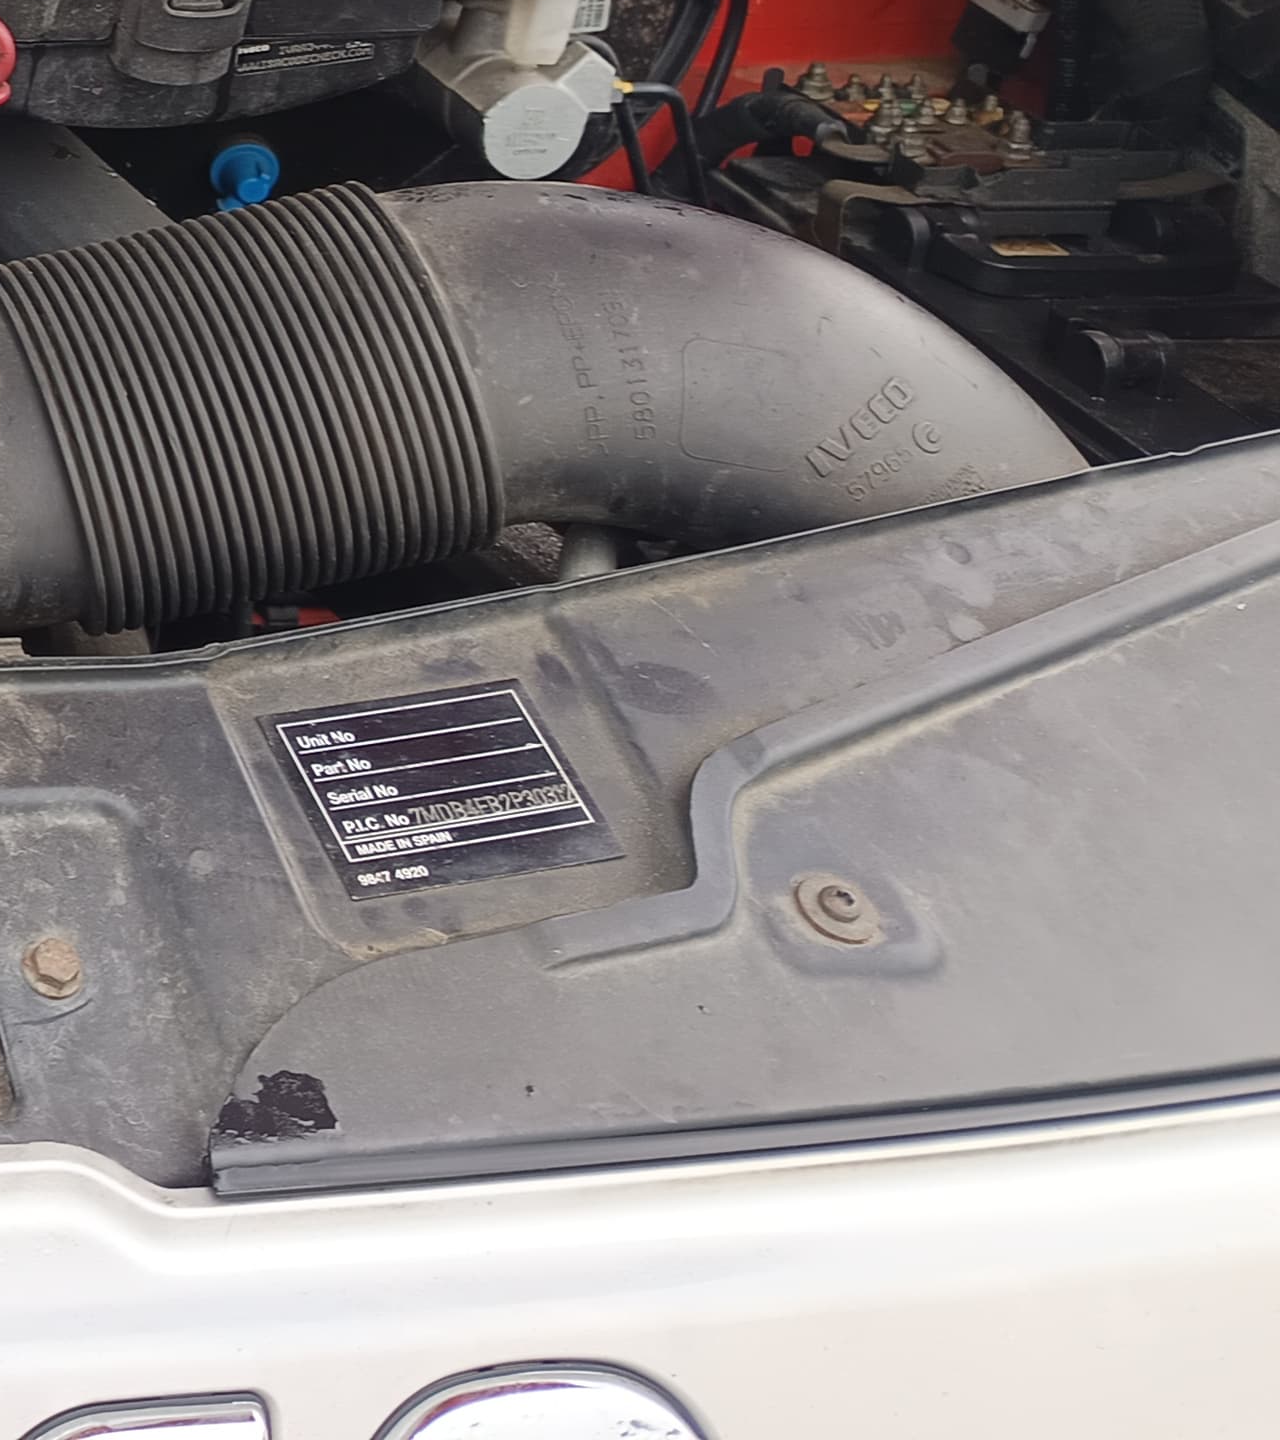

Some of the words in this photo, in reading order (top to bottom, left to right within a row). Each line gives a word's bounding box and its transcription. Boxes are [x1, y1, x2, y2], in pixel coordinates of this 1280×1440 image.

[805, 375, 915, 479] IVECO
[296, 734, 332, 749] Unit
[329, 730, 356, 744] No
[310, 761, 349, 777] Part
[345, 757, 372, 772] No
[326, 786, 375, 806] Serial
[372, 784, 399, 798] No
[342, 816, 386, 834] P.I.C.
[384, 813, 410, 828] No
[355, 840, 397, 856] MADE
[395, 837, 413, 850] IN
[411, 831, 453, 848] SPAIN
[395, 864, 430, 880] 4920
